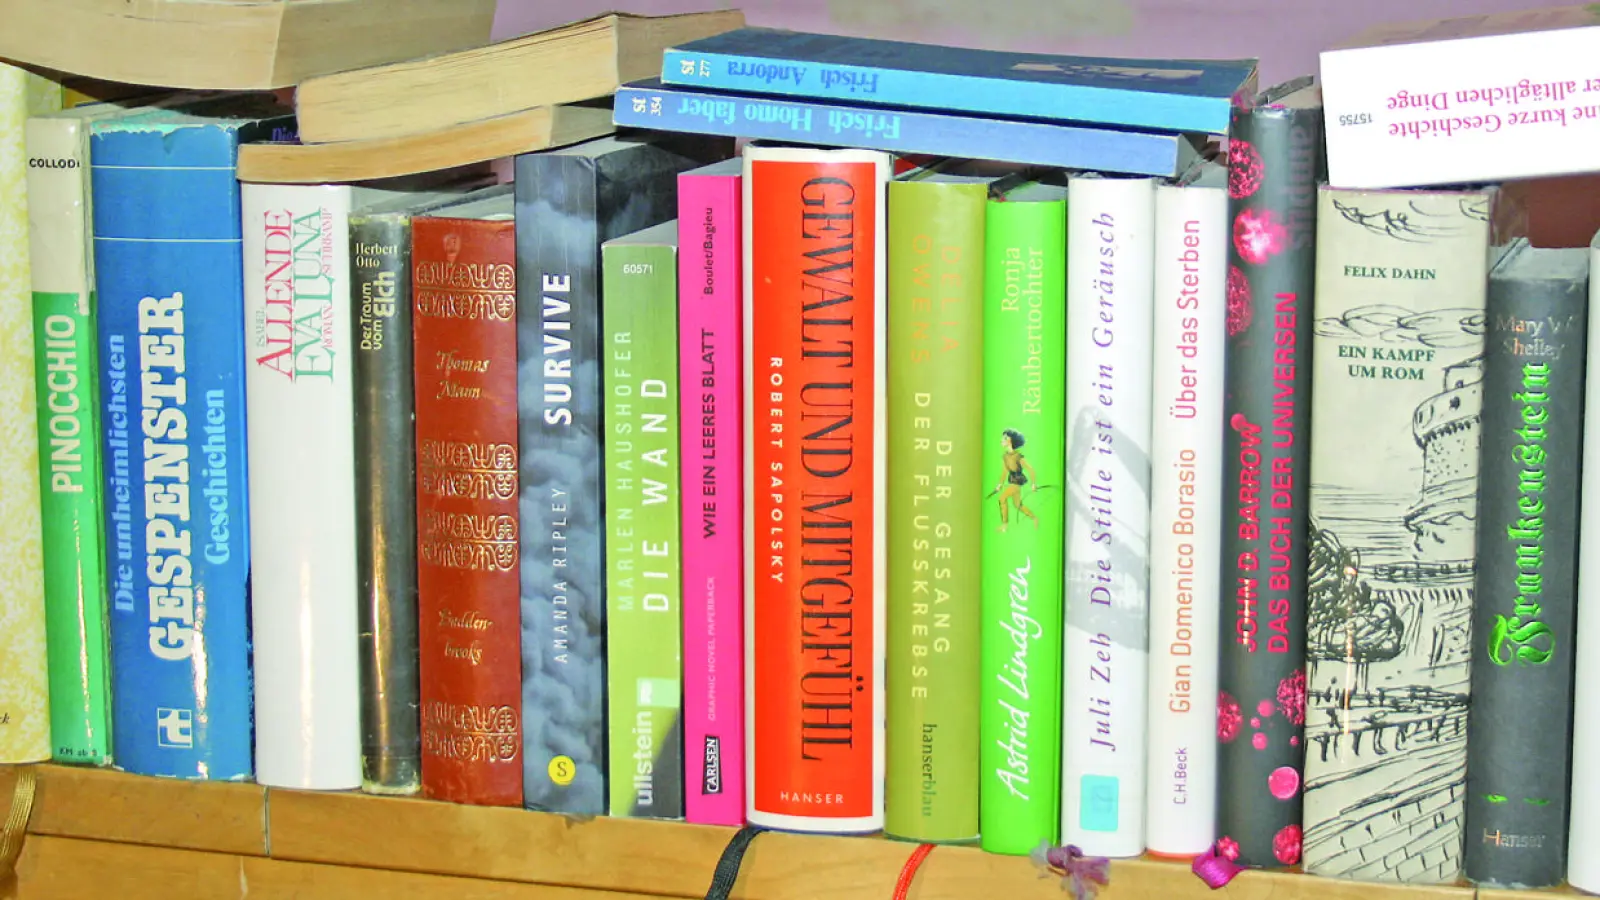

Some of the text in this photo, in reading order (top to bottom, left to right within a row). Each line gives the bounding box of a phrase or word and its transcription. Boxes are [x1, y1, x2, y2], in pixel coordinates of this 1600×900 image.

[650, 96, 663, 117] 354
[676, 97, 902, 139] Frisch Homo faber
[700, 60, 711, 77] 277
[727, 60, 880, 93] Frisch Andorra
[1338, 112, 1373, 126] 15755
[1386, 89, 1448, 111] Dinge
[1455, 78, 1577, 107] alltäglichen
[1388, 105, 1600, 140] ne kurze Geschichte
[255, 207, 295, 385] ALLENDE
[292, 205, 336, 386] EVA LUNA
[355, 241, 400, 256] Herbert
[355, 255, 381, 269] Otto
[622, 262, 655, 275] 60571
[702, 206, 717, 296] Boulet/Bagieu
[911, 233, 932, 364] OWENS
[939, 245, 962, 353] DELIA
[1001, 246, 1025, 313] Ronja
[1342, 264, 1437, 281] FELIX DAHN
[360, 281, 373, 351] Der Traum
[372, 270, 396, 351] vom Elch
[435, 350, 492, 373] Thomas
[542, 273, 572, 426] SURVIVE
[1020, 246, 1044, 415] Räubertochter
[1338, 345, 1436, 362] EIN KAMPF
[1496, 314, 1545, 337] Mary
[44, 314, 84, 494] PINOCCHIO
[1348, 364, 1425, 381] UM ROM
[106, 333, 135, 613] Die unheimlichsten
[137, 291, 195, 661] GESPENSTER
[200, 388, 231, 566] Geschichten
[614, 330, 635, 613] MARLEN HAUSHOFER
[701, 327, 717, 540] WIE EIN LEERES BLATT
[769, 356, 784, 584] ROBERT SAPOLSKY
[800, 175, 864, 762] GEWALT UND MITGEFÜHL
[1088, 212, 1117, 752] Juli Zeh Die Stille ist ein Geräusch
[1168, 218, 1201, 715] Gian Domenico Borasio Über das Sterben
[1266, 292, 1298, 654] DAS BUCH DER UNIVERSEN
[639, 378, 670, 613] DIE WAND
[911, 391, 931, 700] DER FLUSSKREBSE
[1235, 418, 1263, 653] JOHN D. BARROW
[551, 487, 569, 664] AMANDA RIPLEY
[932, 439, 953, 655] DER GESANG
[706, 576, 718, 722] GRAPHIC NOVEL PAPERBACK
[994, 554, 1044, 801] Astrid Lindgren
[631, 709, 654, 806] ullstein
[705, 736, 720, 794] CARLSEN
[780, 791, 845, 805] HANSER
[1481, 827, 1547, 849] Hanser
